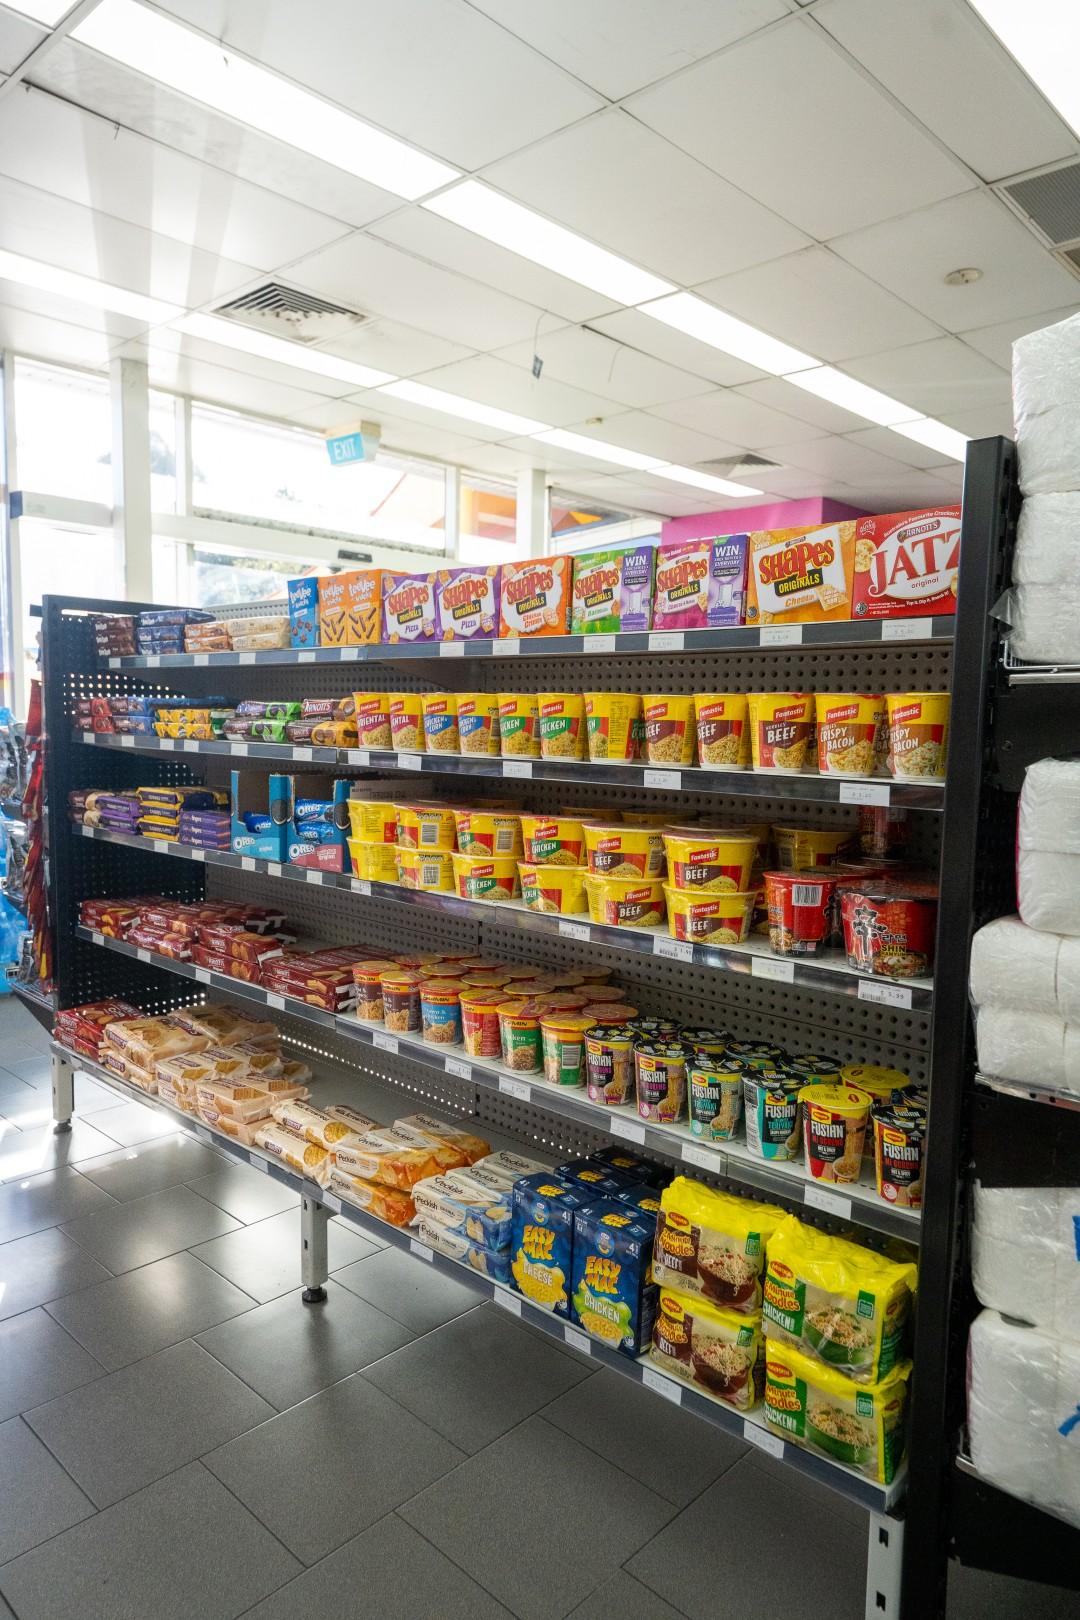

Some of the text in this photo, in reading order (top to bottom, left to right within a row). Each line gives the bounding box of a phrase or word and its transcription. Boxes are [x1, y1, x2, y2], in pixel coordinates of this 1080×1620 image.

[334, 438, 356, 461] EXIT
[715, 545, 740, 557] WIN
[625, 555, 648, 568] WIN
[778, 574, 820, 594] ORIGINALS
[911, 576, 939, 589] original
[670, 584, 699, 599] ORIGINALS
[775, 706, 804, 719] Fantastic
[828, 706, 857, 719] Fantastic
[767, 725, 796, 744] BEEF
[820, 727, 848, 743] CRISPY
[828, 737, 855, 751] BACON
[894, 737, 919, 753] BACON
[296, 805, 320, 816] OREO
[233, 837, 256, 852] OREO
[289, 843, 315, 859] OREO
[532, 841, 557, 853] CHICKEN
[595, 855, 612, 866] BEEF
[691, 851, 717, 861] Fantastic
[686, 868, 709, 881] BEEF
[620, 906, 641, 918] BEEF
[692, 904, 719, 914] Fantastic
[686, 920, 709, 932] BEEF
[881, 944, 906, 953] SHIN
[640, 1069, 666, 1083] FUSIAN
[692, 1084, 719, 1100] FUSIAN
[765, 1105, 796, 1118] FUSIAN
[811, 1121, 844, 1139] FUSIAN
[883, 1142, 919, 1161] FUSIAN
[523, 1225, 555, 1246] EASY
[523, 1240, 553, 1260] MAC
[660, 1239, 695, 1257] Noodles
[523, 1262, 552, 1286] CHEESE
[586, 1256, 621, 1277] EASY
[586, 1274, 619, 1295] MAC
[584, 1294, 620, 1323] CHICKEN
[764, 1291, 800, 1311] Noodles
